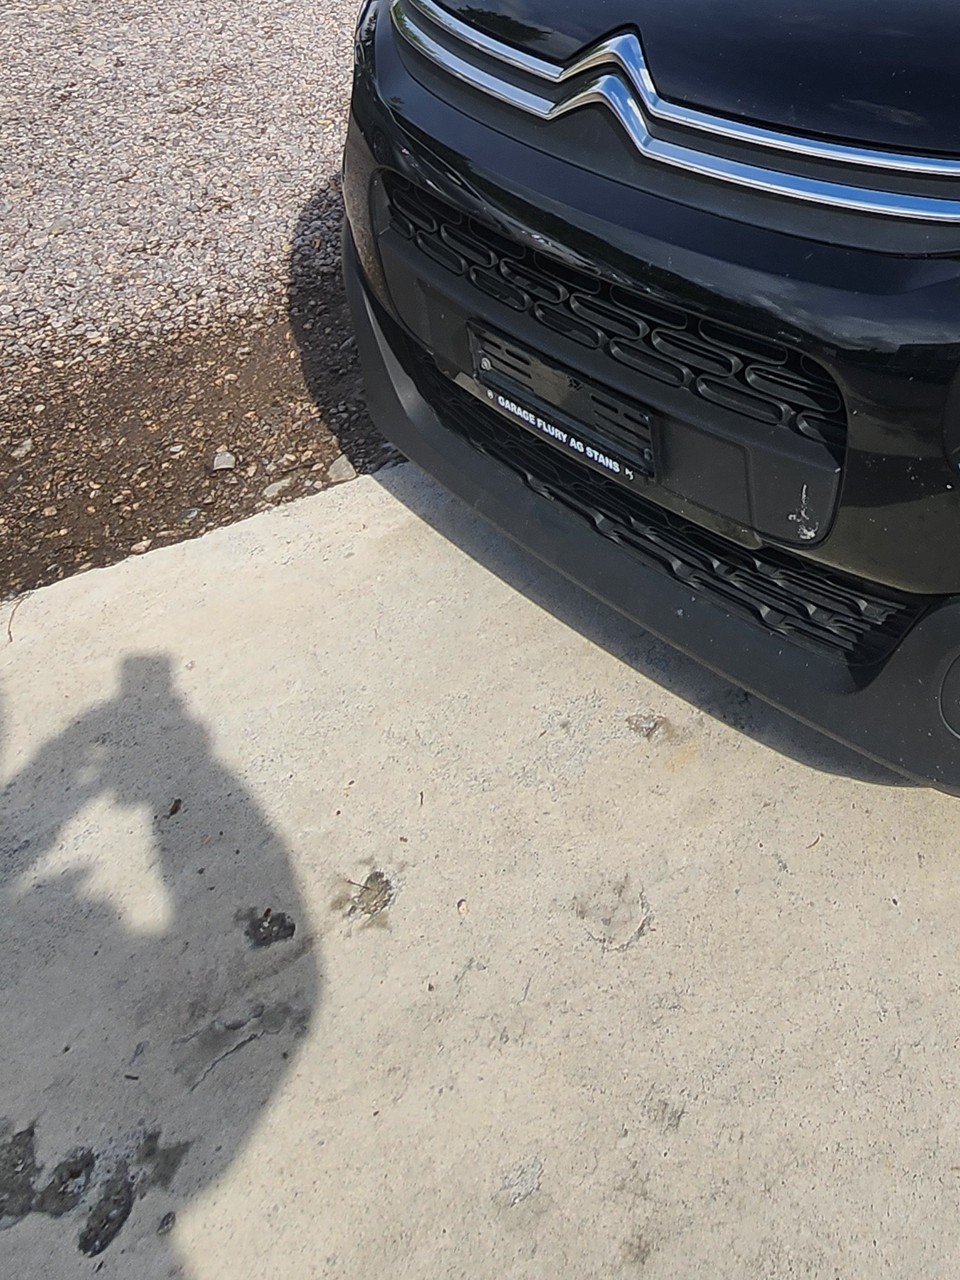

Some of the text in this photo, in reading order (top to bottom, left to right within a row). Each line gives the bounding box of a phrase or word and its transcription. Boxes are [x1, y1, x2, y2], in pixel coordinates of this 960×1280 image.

[498, 396, 621, 473] GARAGE FLURY AG STANS
